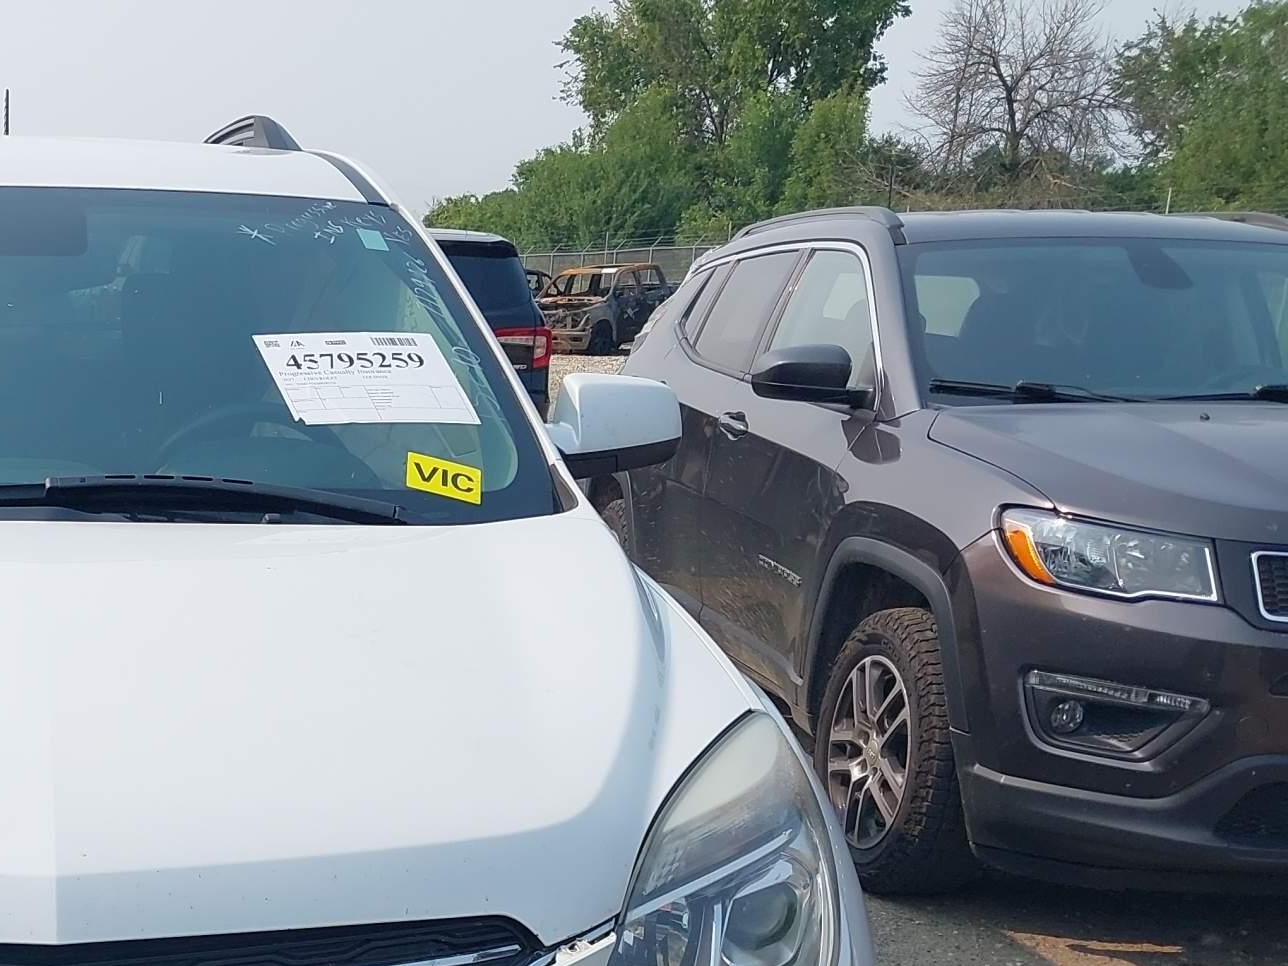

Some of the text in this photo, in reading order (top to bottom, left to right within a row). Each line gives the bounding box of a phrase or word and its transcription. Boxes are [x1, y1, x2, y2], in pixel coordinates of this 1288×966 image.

[286, 352, 425, 370] 45795259
[278, 369, 323, 377] Progressive
[414, 462, 474, 493] VIC
